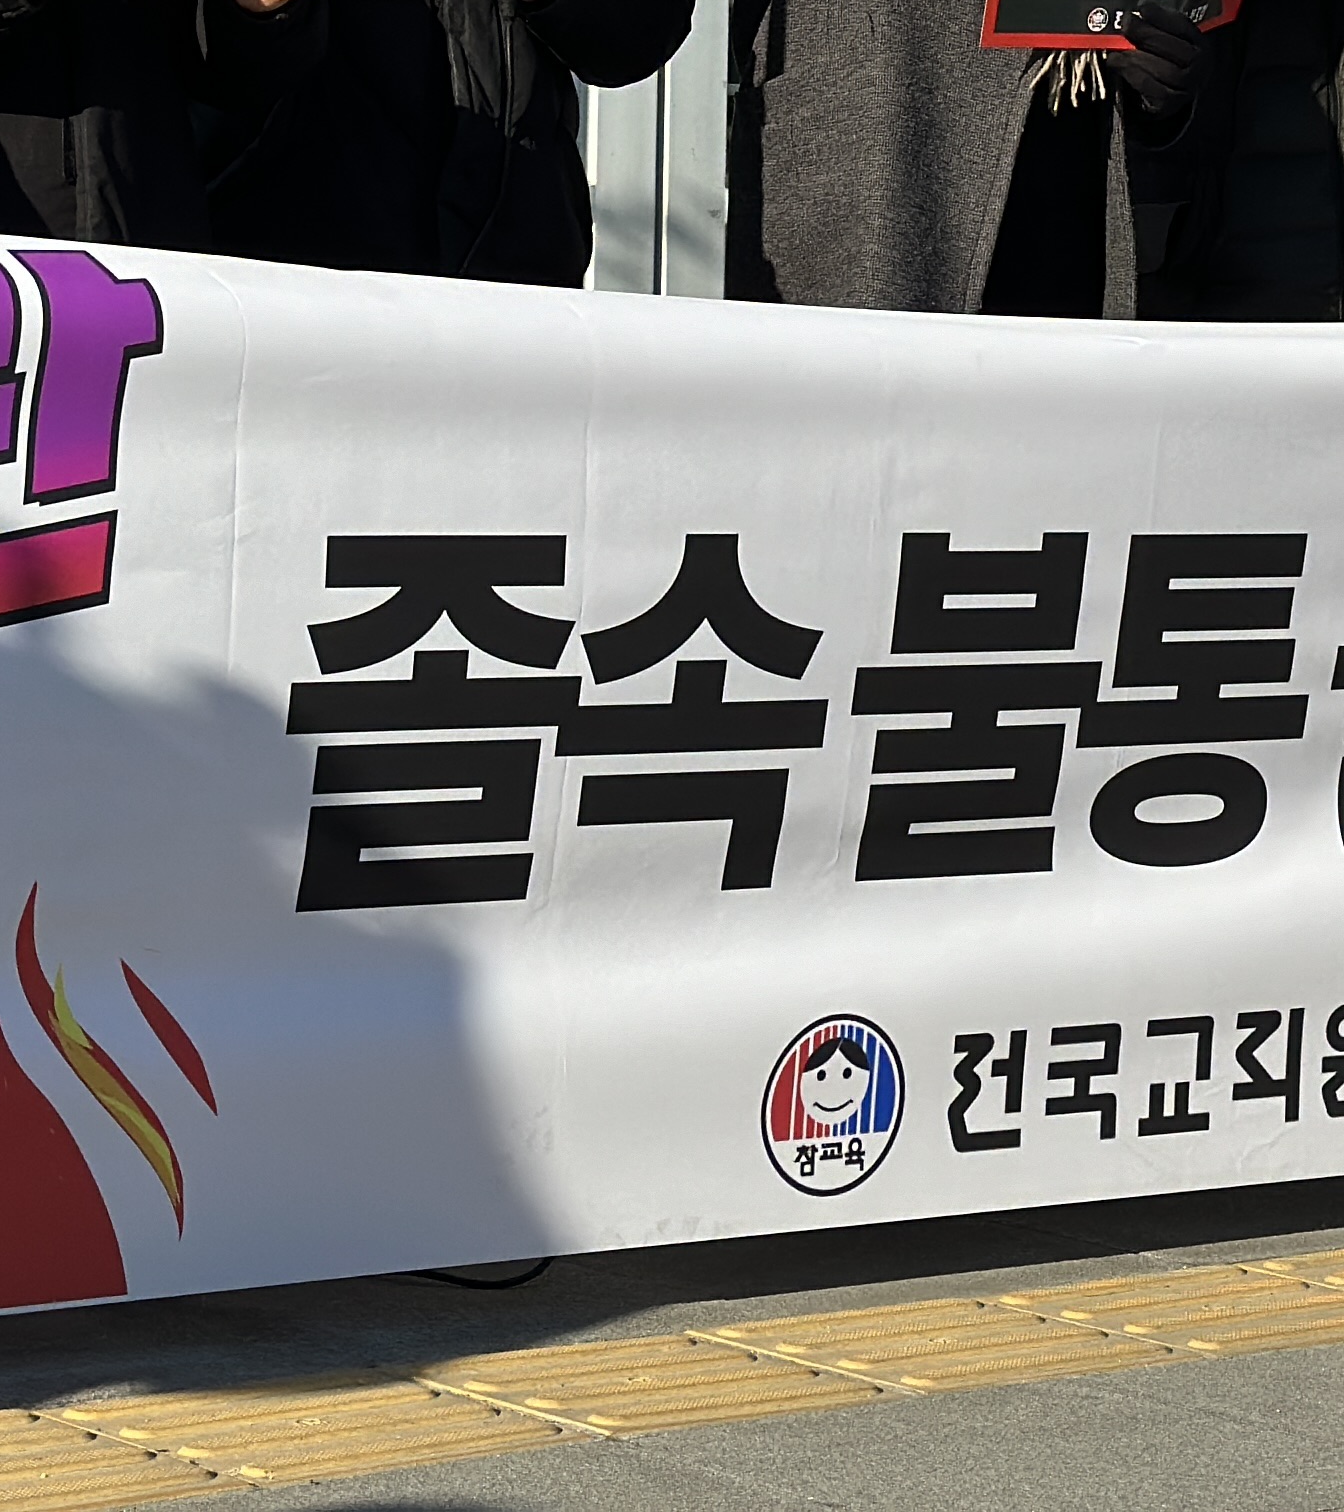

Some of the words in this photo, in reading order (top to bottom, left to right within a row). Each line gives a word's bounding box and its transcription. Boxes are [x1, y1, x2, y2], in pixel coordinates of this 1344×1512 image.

[286, 532, 829, 914] 졸속
[850, 530, 1309, 882] 불통
[793, 1137, 866, 1177] 참교육
